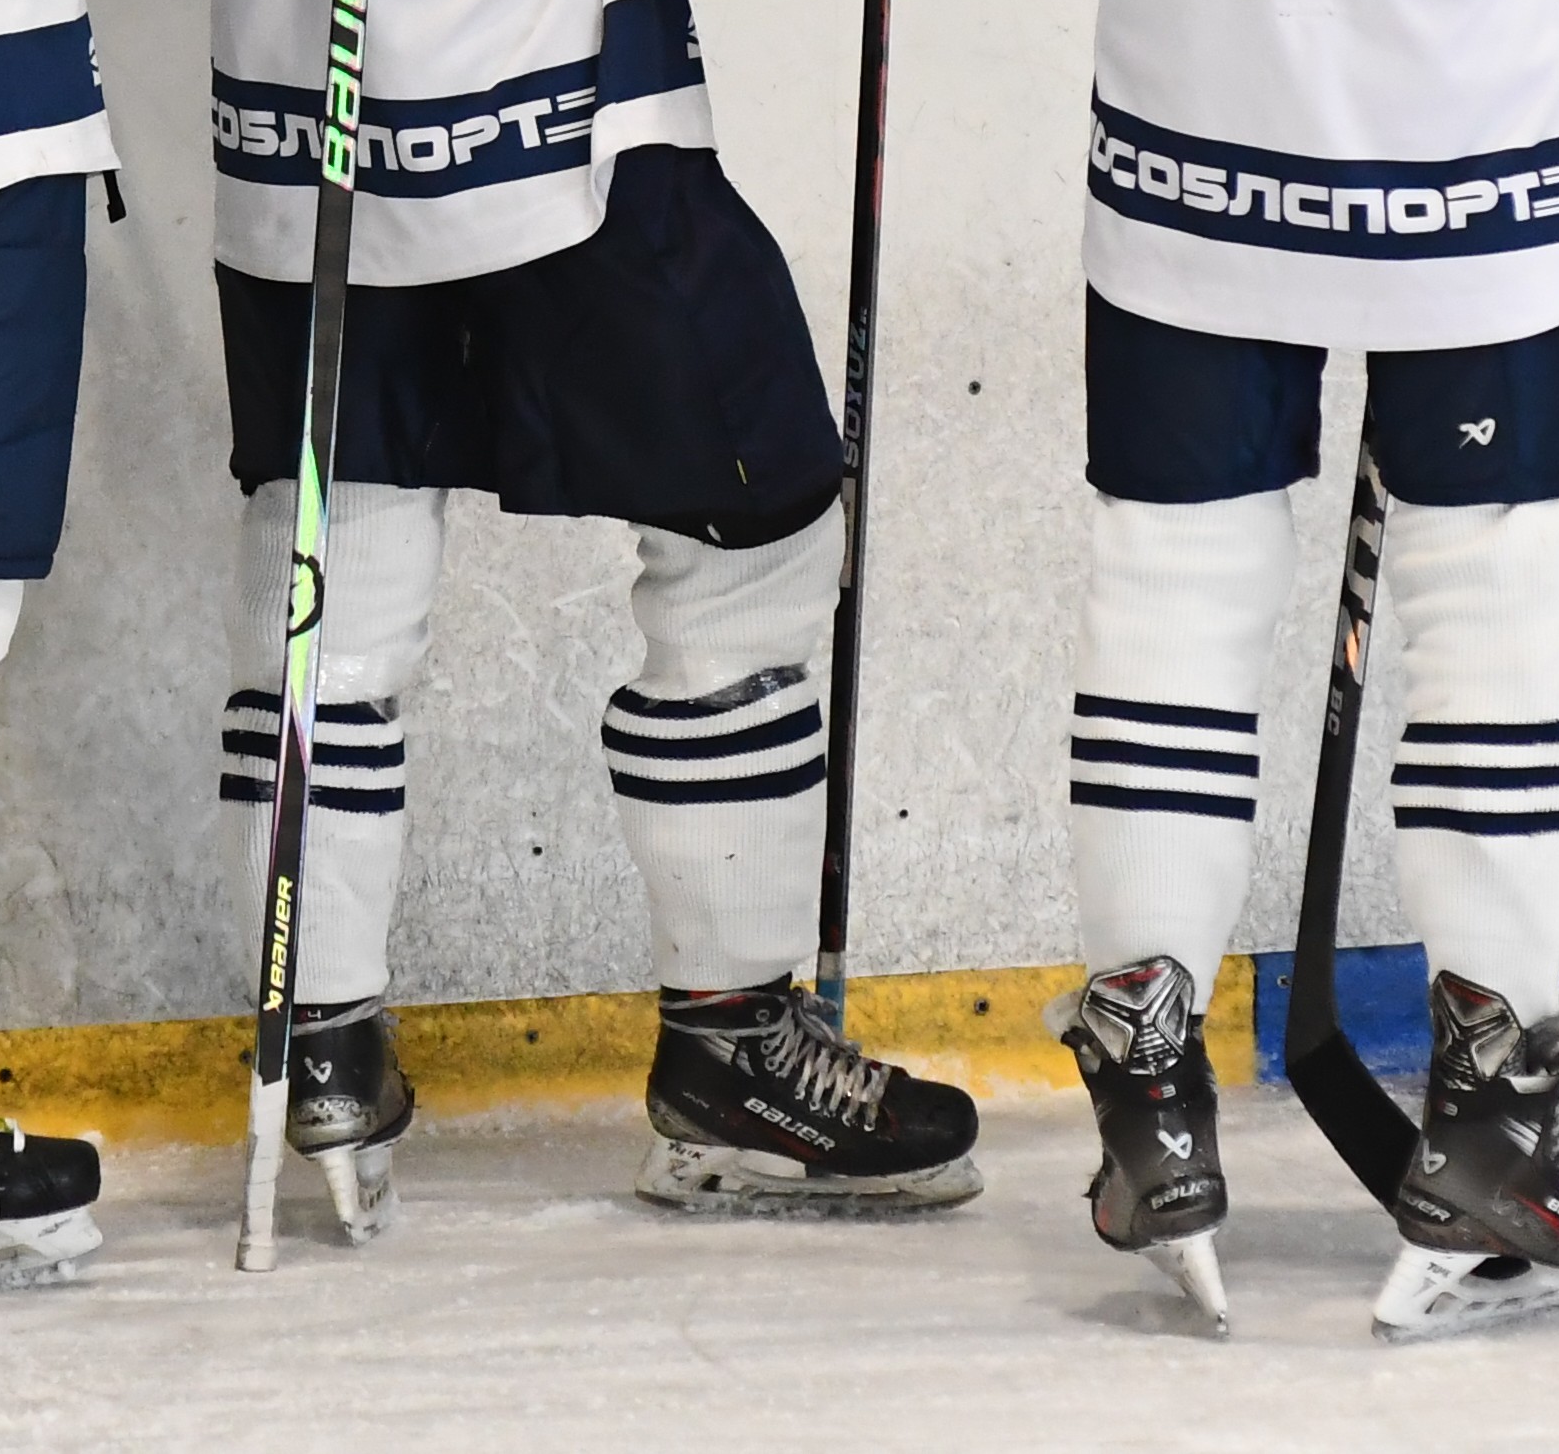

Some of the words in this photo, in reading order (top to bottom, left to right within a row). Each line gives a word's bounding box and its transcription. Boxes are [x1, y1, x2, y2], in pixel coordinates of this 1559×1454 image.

[842, 320, 869, 470] SOYUZ
[270, 875, 293, 987] BAUER
[743, 1096, 836, 1152] BAUER
